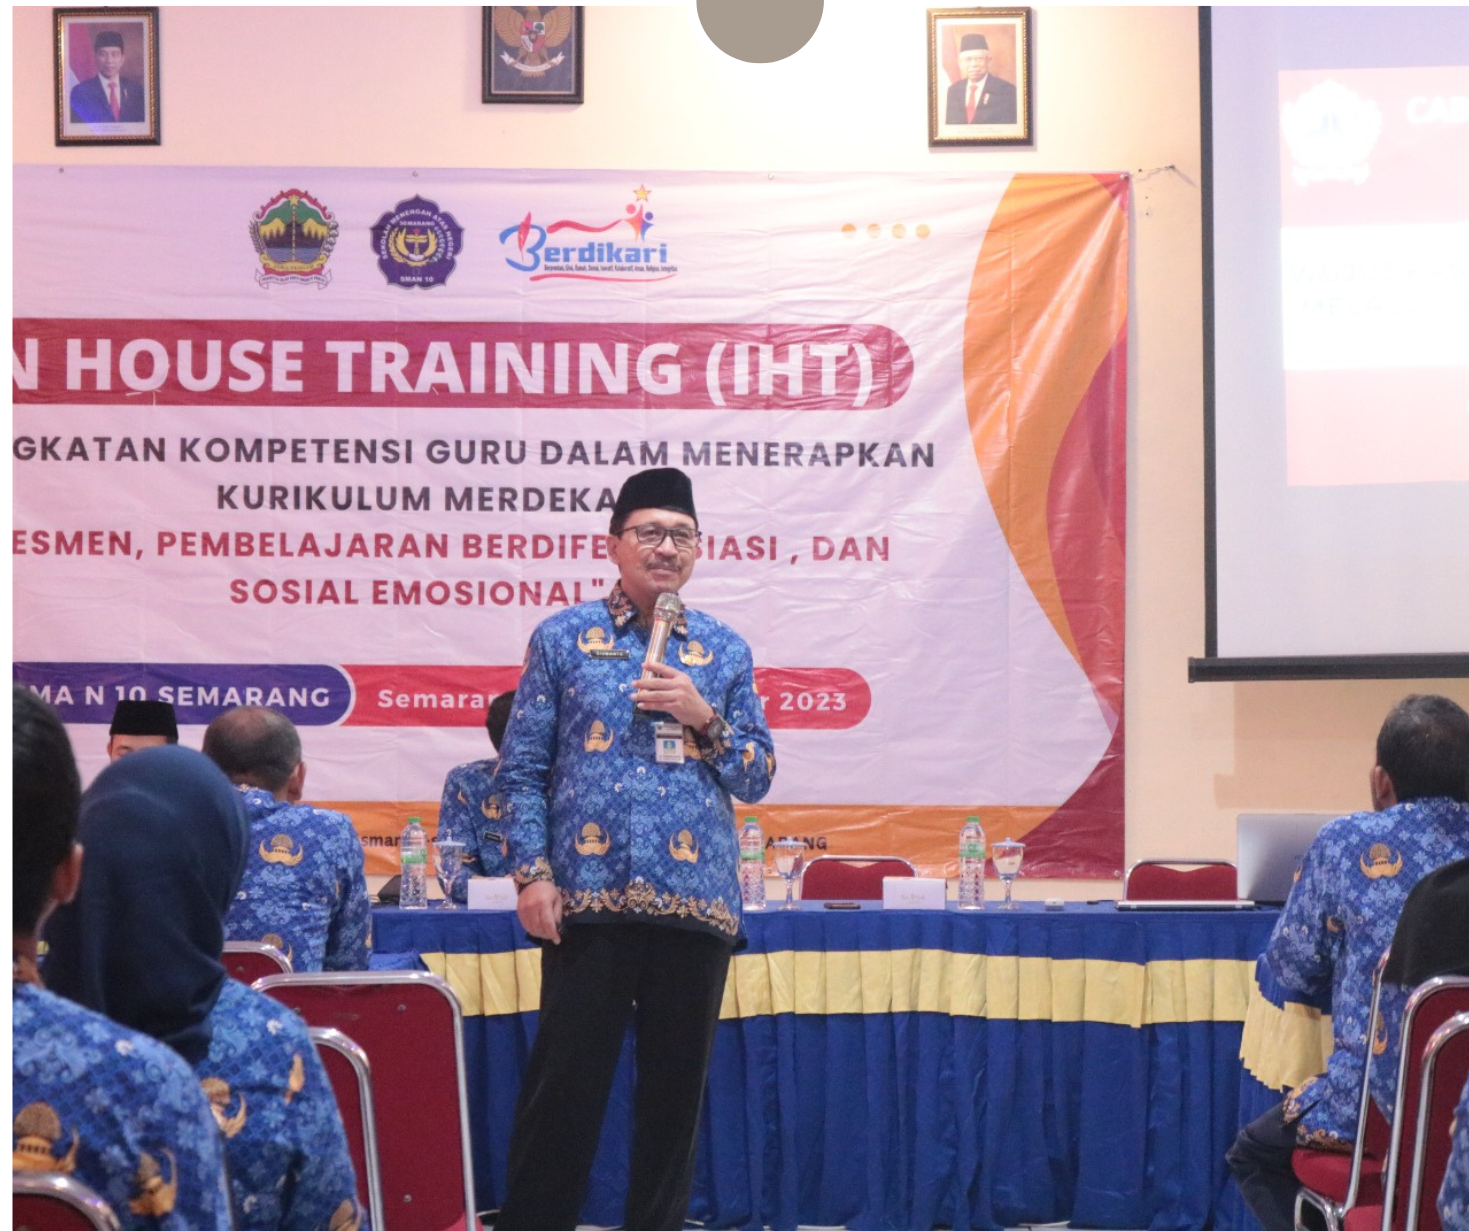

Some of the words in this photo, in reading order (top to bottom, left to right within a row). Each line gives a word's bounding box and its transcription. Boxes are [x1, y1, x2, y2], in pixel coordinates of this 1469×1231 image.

[499, 223, 668, 272] Berdikari
[66, 338, 303, 394] HOUSE
[323, 340, 681, 396] TRAINING
[706, 342, 873, 406] (IHT)
[179, 437, 413, 466] KOMPETENSI
[426, 439, 527, 467] GURU
[540, 440, 668, 467] DALAM
[682, 441, 935, 468] MENERAPKAN
[217, 484, 431, 511] KURIKULUM
[444, 486, 615, 512] MERDEKA
[157, 533, 449, 560] PEMBELAJARAN
[812, 536, 890, 562] DAN
[230, 578, 358, 605] SOSIAL
[372, 578, 604, 606] EMOSIONAL"
[29, 685, 74, 705] MA
[85, 685, 104, 705] N
[115, 685, 147, 701] 10
[158, 685, 330, 707] SEMARANG
[779, 691, 847, 711] 2023
